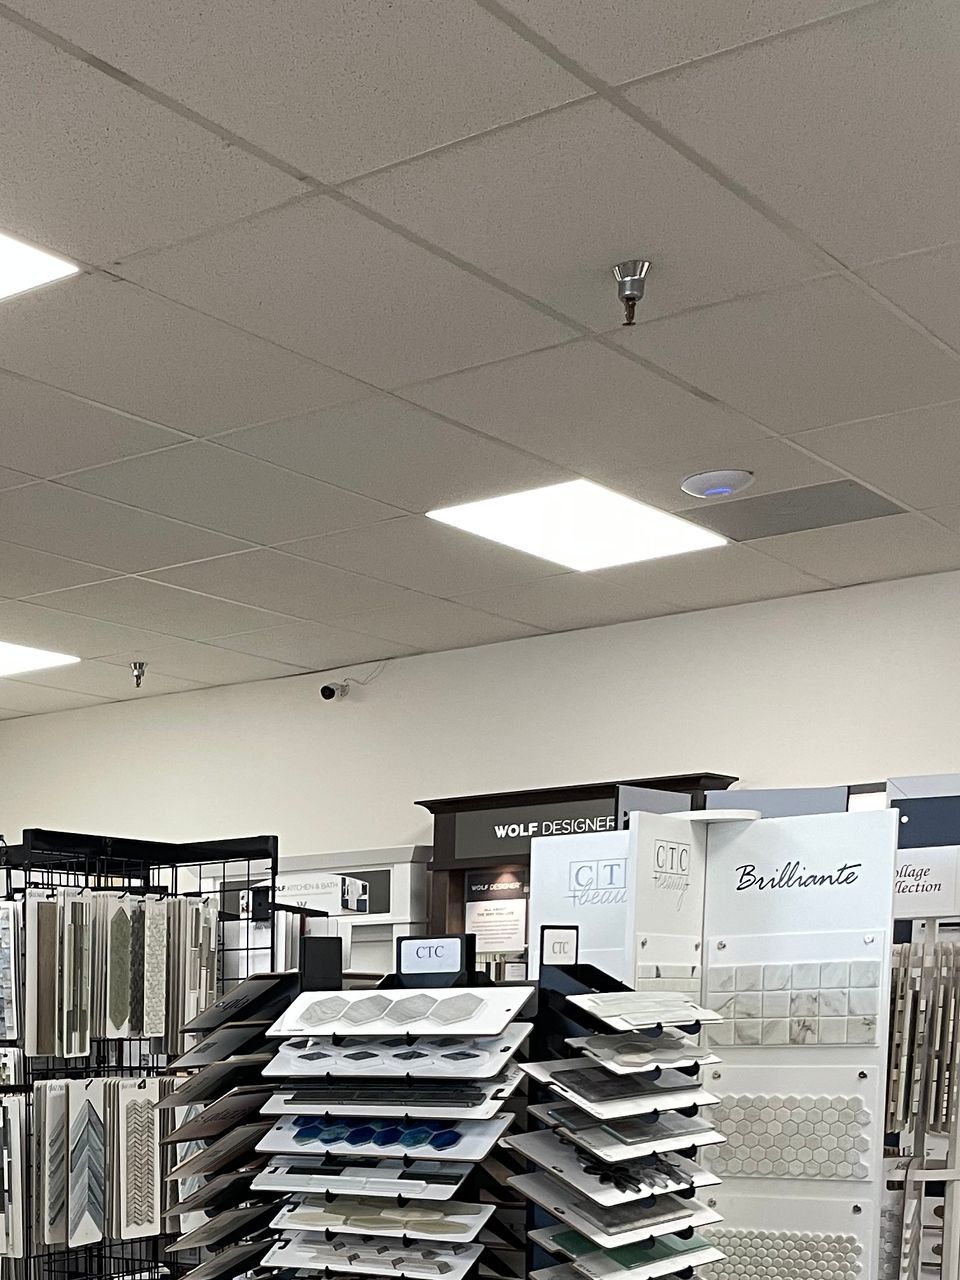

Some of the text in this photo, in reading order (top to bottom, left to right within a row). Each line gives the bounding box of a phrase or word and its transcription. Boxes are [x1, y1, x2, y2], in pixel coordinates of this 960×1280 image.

[494, 815, 616, 839] WOLF DESIGNER
[656, 845, 688, 872] CTC
[736, 861, 862, 891] Brilliante
[415, 945, 445, 959] CTC
[552, 941, 569, 955] CTC
